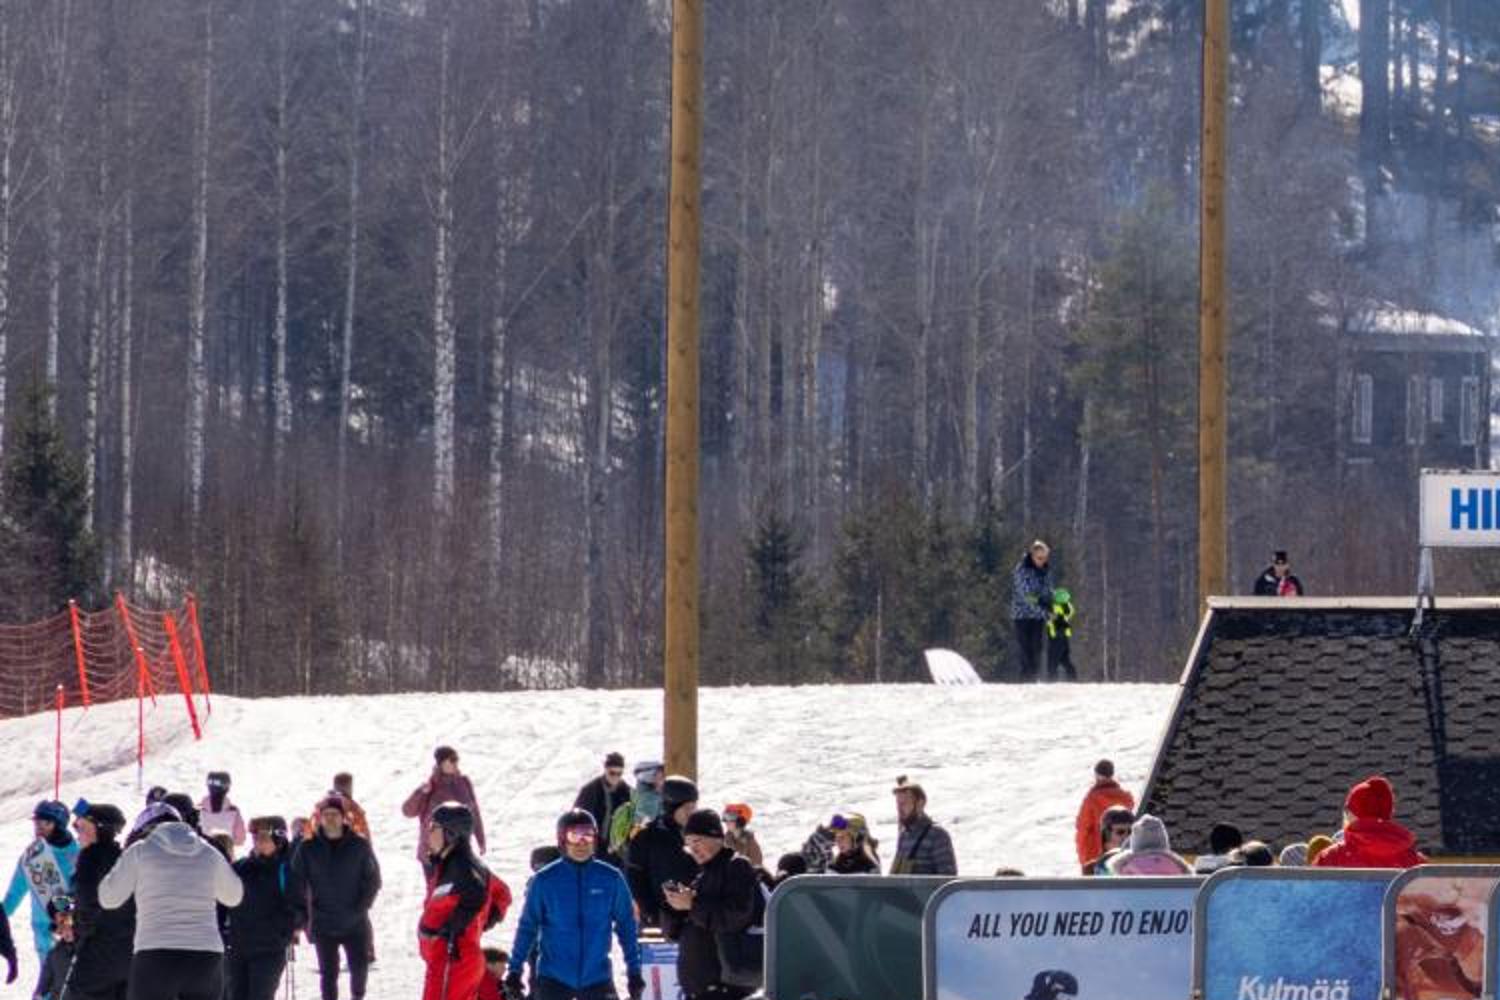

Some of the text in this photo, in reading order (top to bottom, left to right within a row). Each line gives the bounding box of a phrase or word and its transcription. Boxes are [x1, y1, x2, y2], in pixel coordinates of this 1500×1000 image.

[968, 909, 1193, 939] ALL YOU NEED TO ENJO
